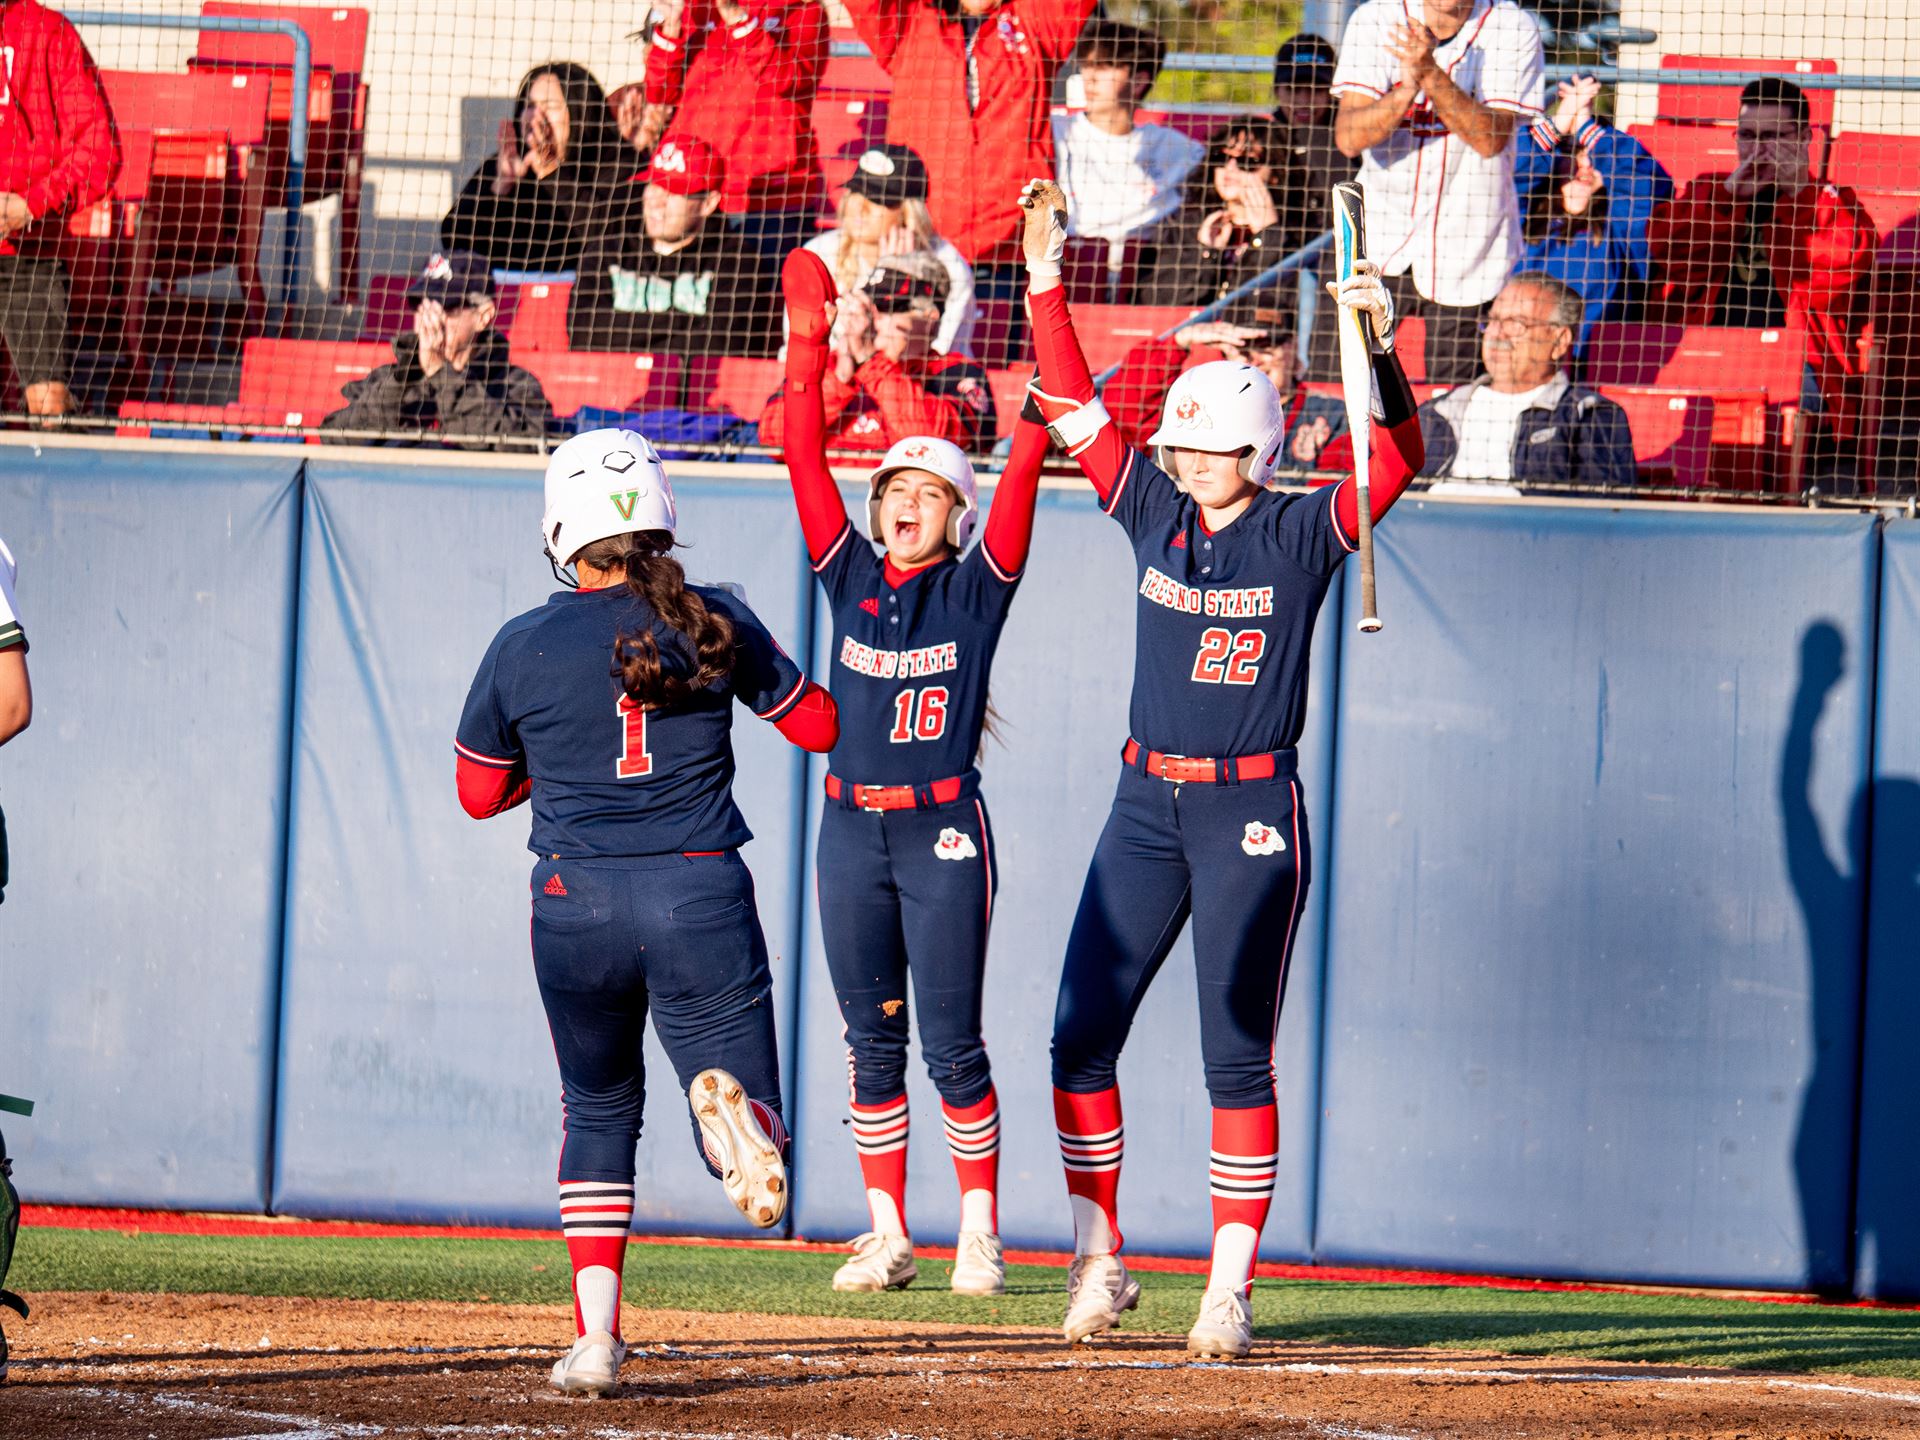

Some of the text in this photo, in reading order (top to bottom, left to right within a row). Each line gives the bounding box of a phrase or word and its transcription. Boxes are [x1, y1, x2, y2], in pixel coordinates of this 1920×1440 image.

[608, 488, 639, 521] V
[1204, 586, 1273, 618] STATE
[897, 641, 957, 679] STATE
[1191, 627, 1266, 685] 22
[616, 692, 652, 779] 1
[890, 686, 949, 743] 16
